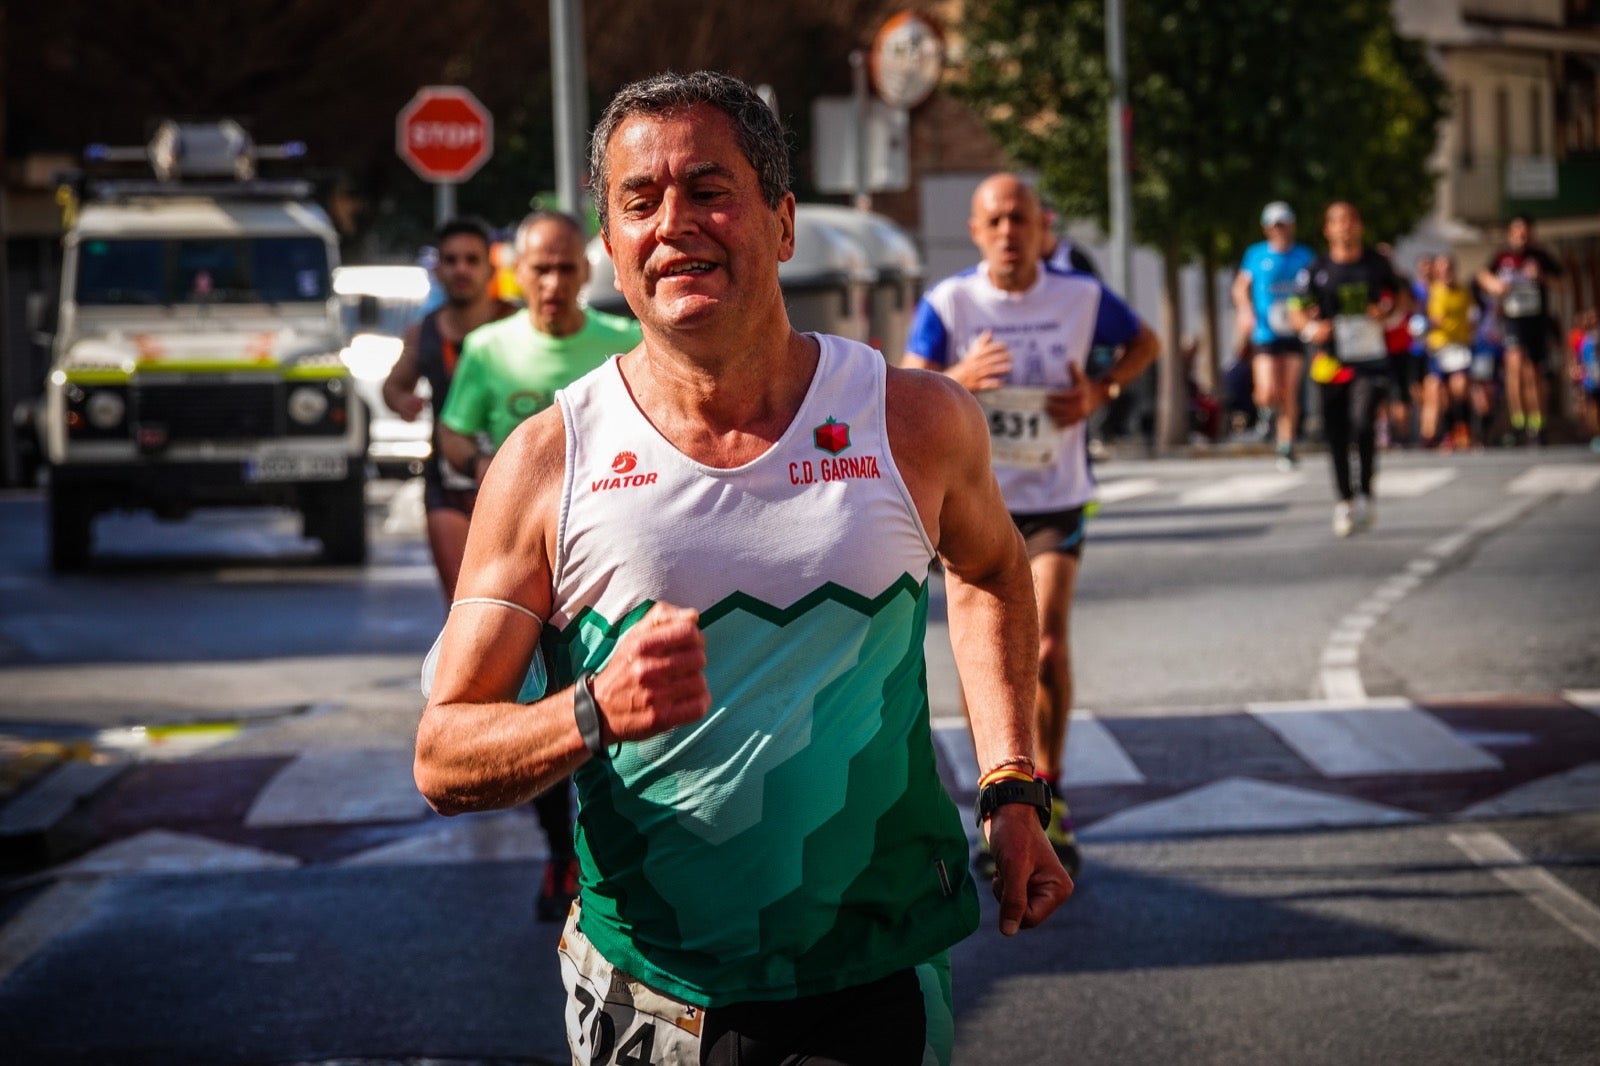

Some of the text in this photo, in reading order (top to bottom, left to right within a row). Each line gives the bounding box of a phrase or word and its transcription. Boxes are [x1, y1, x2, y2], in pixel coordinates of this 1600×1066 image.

[409, 121, 481, 149] STOP
[591, 472, 657, 492] VIATOR
[789, 455, 881, 485] C.D. GARNATA
[574, 983, 656, 1066] 704
